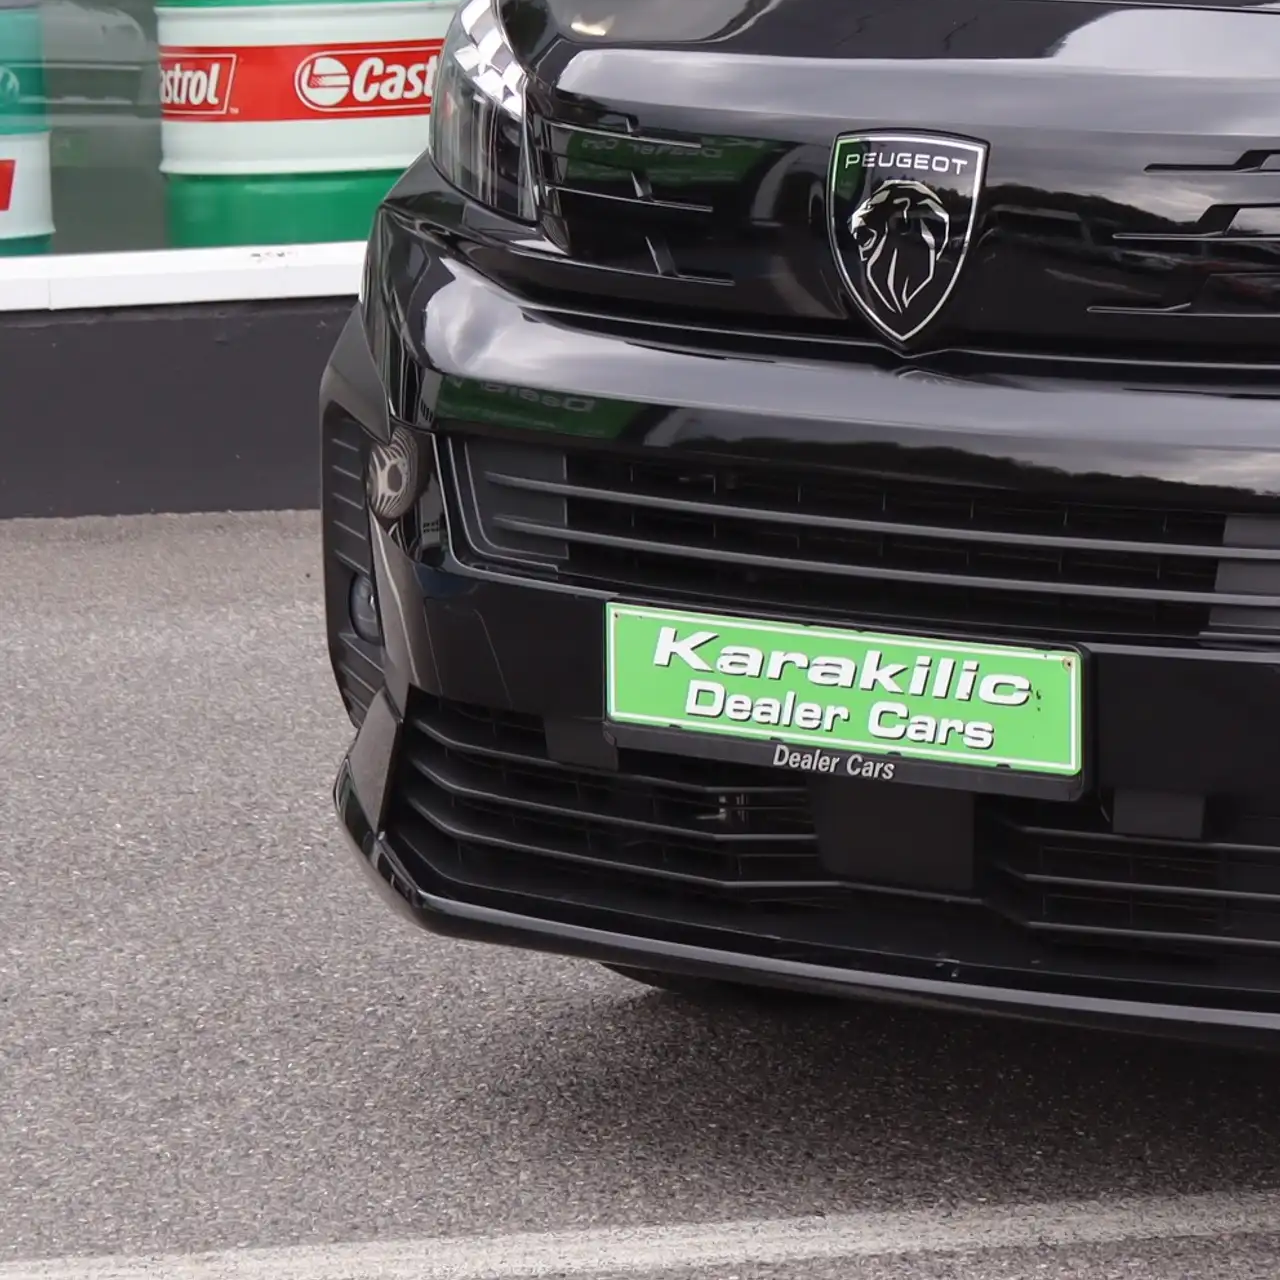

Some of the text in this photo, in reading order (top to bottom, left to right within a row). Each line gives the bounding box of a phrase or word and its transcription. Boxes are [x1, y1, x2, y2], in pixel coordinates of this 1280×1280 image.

[160, 62, 220, 107] astrol
[352, 55, 439, 102] Cast
[845, 152, 968, 175] PEUGEOT
[652, 626, 1033, 706] Karakilic
[685, 679, 994, 749] Dealer Cars
[773, 745, 895, 780] Dealer Cars
